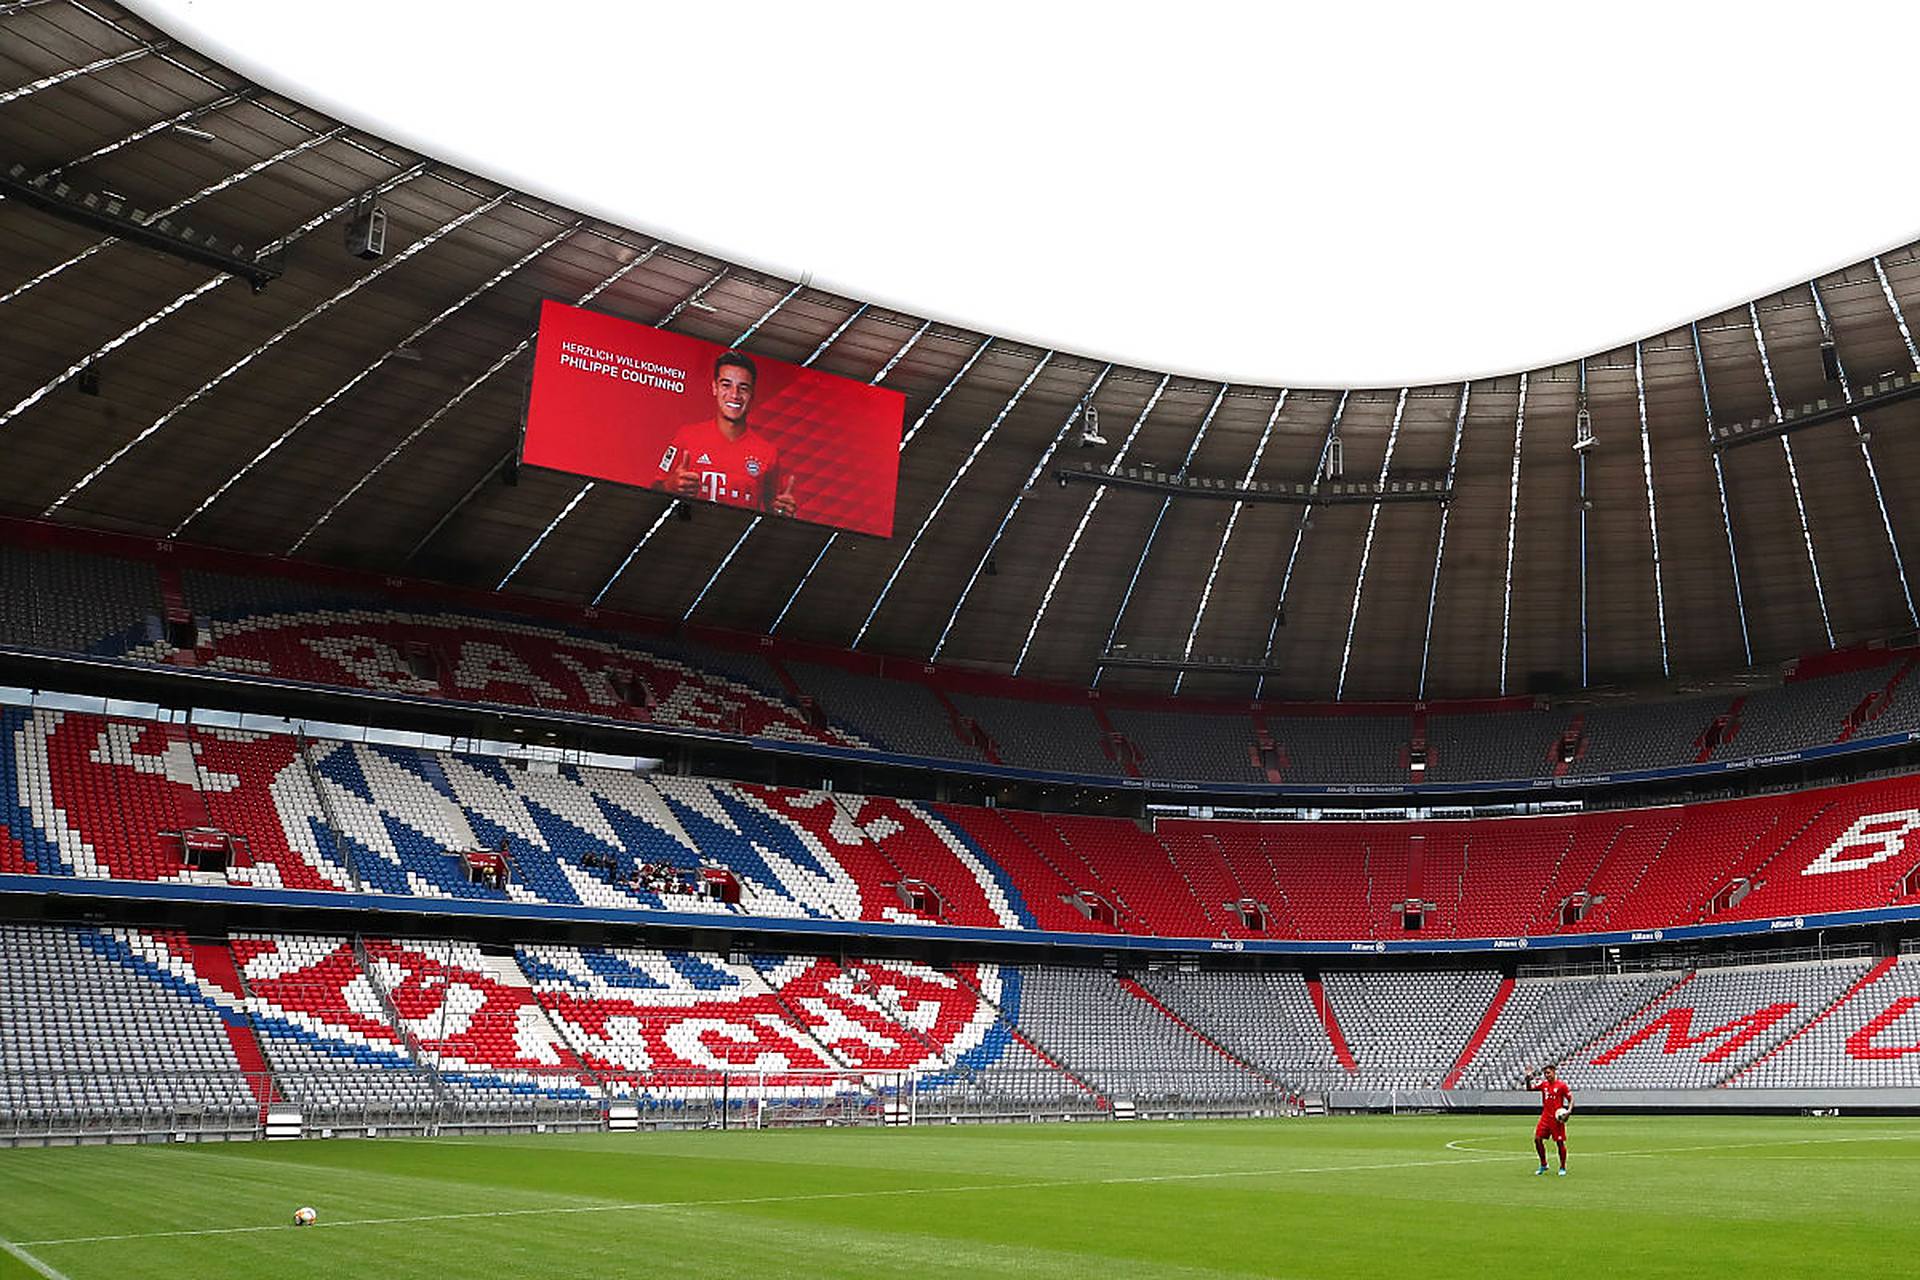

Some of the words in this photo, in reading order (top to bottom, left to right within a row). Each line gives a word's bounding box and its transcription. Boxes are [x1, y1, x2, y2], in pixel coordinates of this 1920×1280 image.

[562, 341, 614, 362] HERZLICH
[616, 354, 686, 380] WILLKOMMEN
[560, 353, 619, 378] PHILIPPE
[621, 369, 685, 393] COUTINHO
[1771, 920, 1794, 929] Allianz
[1631, 932, 1654, 941] Allianz
[1211, 941, 1234, 950] Allianz
[1351, 942, 1376, 951] Allianz
[1493, 939, 1518, 949] Allianz
